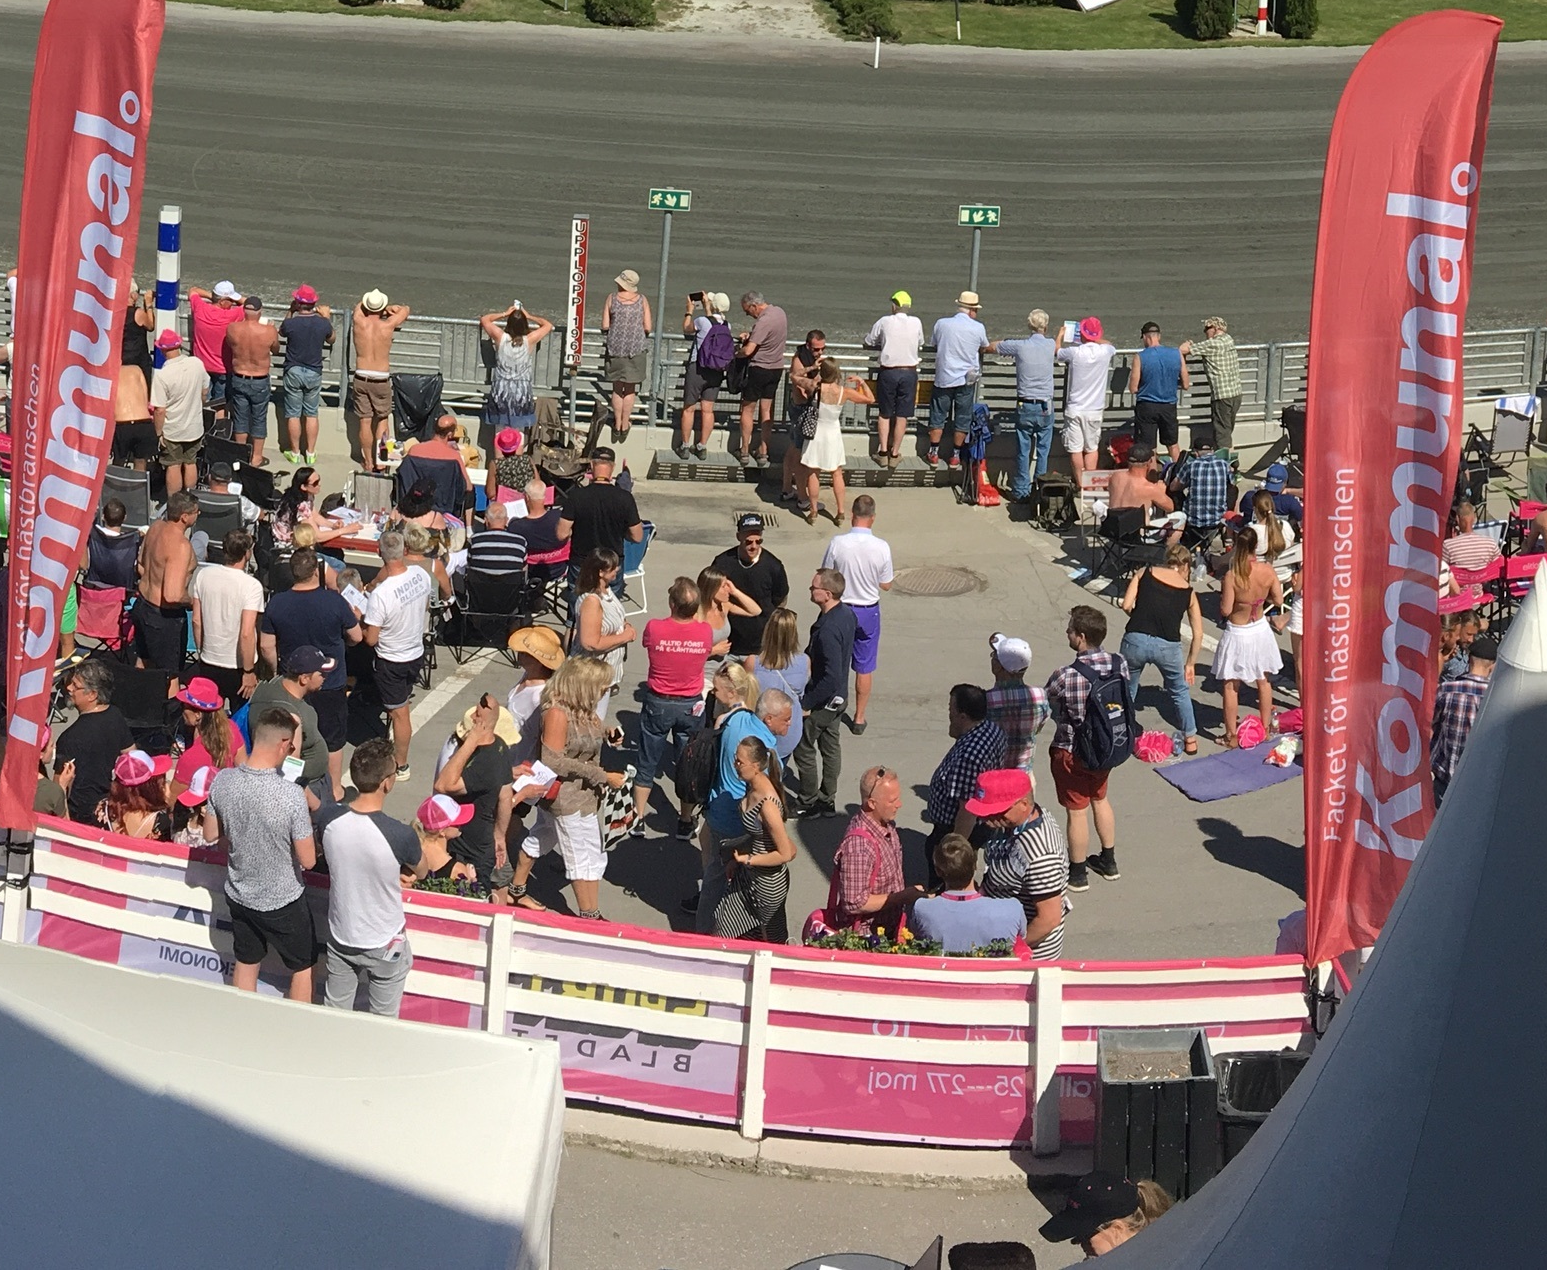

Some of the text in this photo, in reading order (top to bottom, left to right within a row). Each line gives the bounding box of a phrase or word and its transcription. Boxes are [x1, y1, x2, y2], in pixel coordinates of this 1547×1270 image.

[571, 221, 587, 307] UPPLOPP
[394, 573, 423, 600] INDIGO
[399, 585, 425, 603] BLUES
[1322, 468, 1356, 844] Facket för hästbranschen
